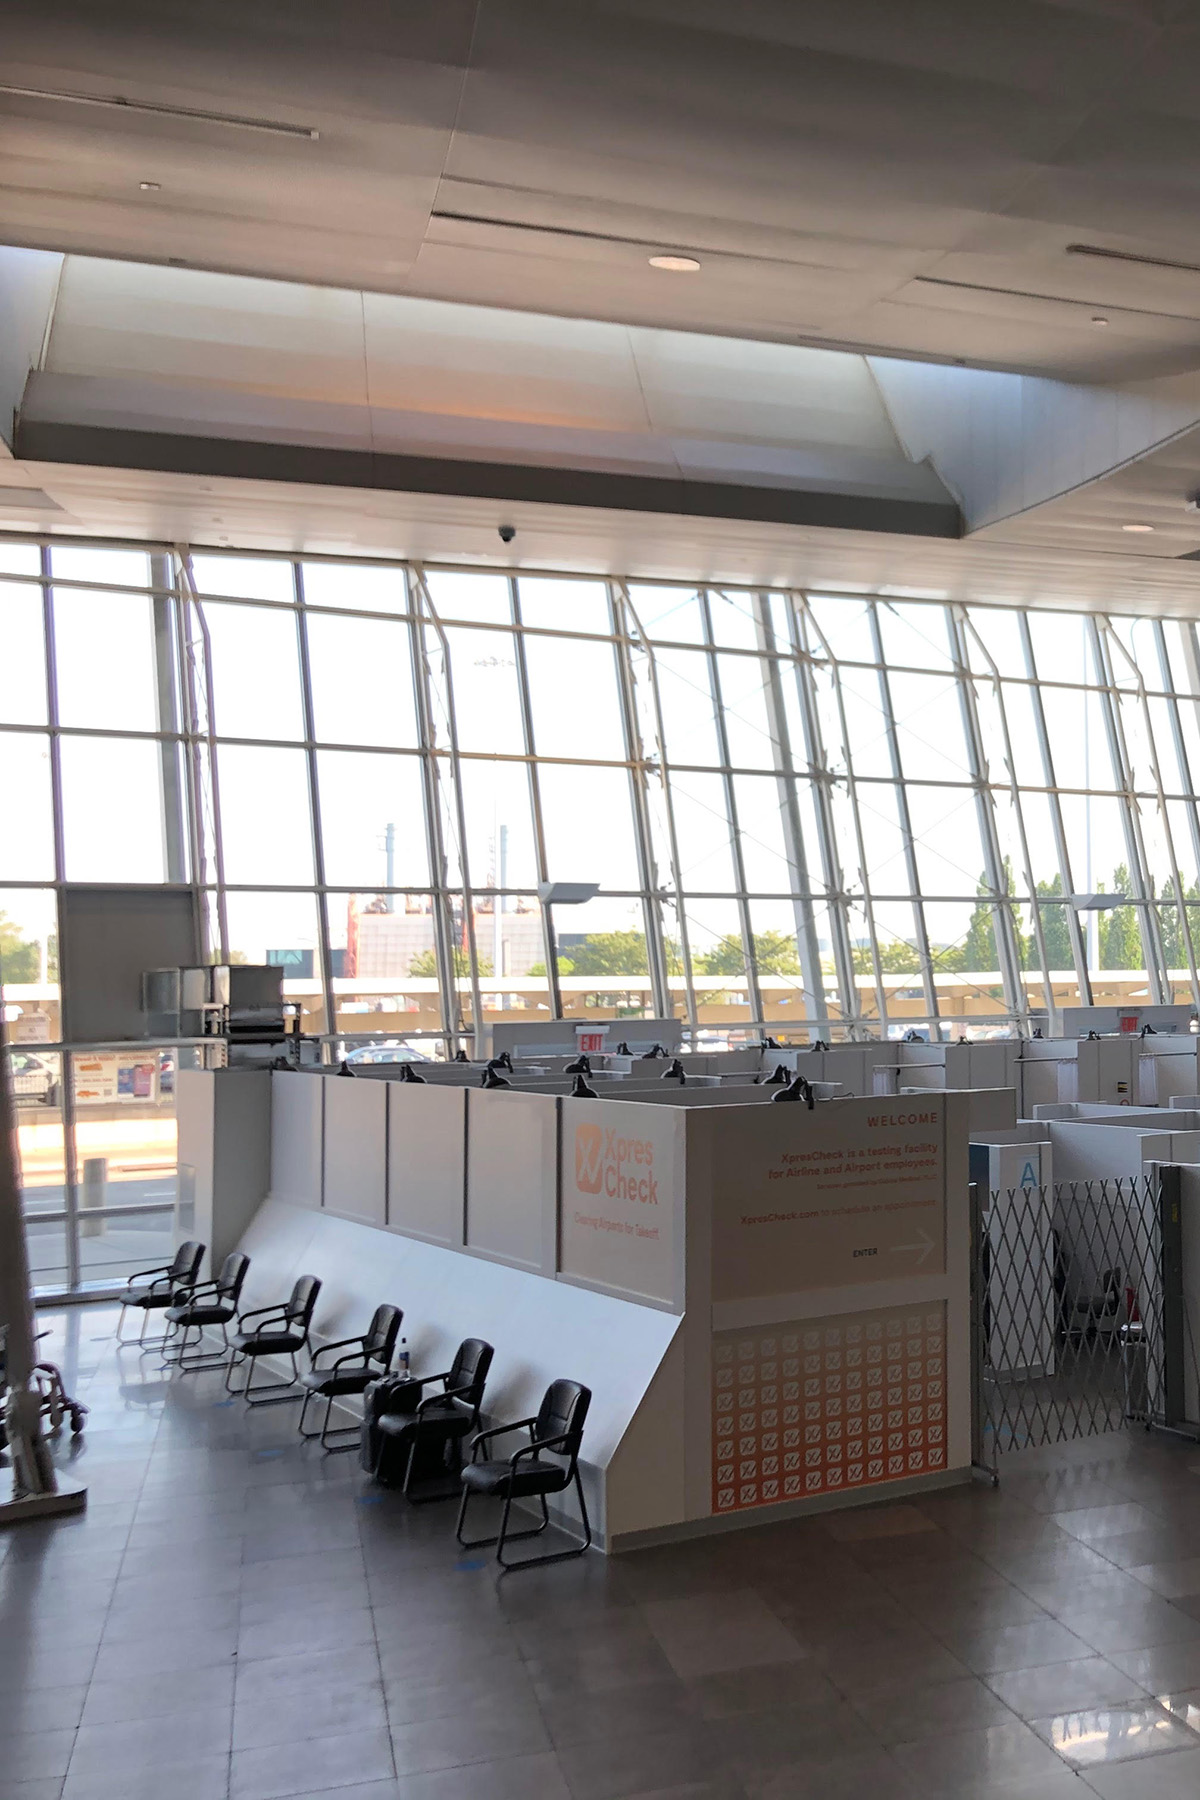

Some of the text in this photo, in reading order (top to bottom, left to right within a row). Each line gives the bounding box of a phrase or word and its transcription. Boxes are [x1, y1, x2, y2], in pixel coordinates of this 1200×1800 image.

[581, 1034, 603, 1051] EXIT
[867, 1112, 938, 1127] WELCOME
[604, 1127, 653, 1167] Xpres
[781, 1143, 938, 1165] XpresCheck is a testing facility
[768, 1169, 784, 1180] for
[786, 1166, 820, 1178] Airline
[823, 1163, 842, 1175] and
[844, 1160, 881, 1174] Airport
[1020, 1162, 1037, 1188] A
[605, 1165, 658, 1205] Check
[853, 1248, 878, 1258] ENTER
